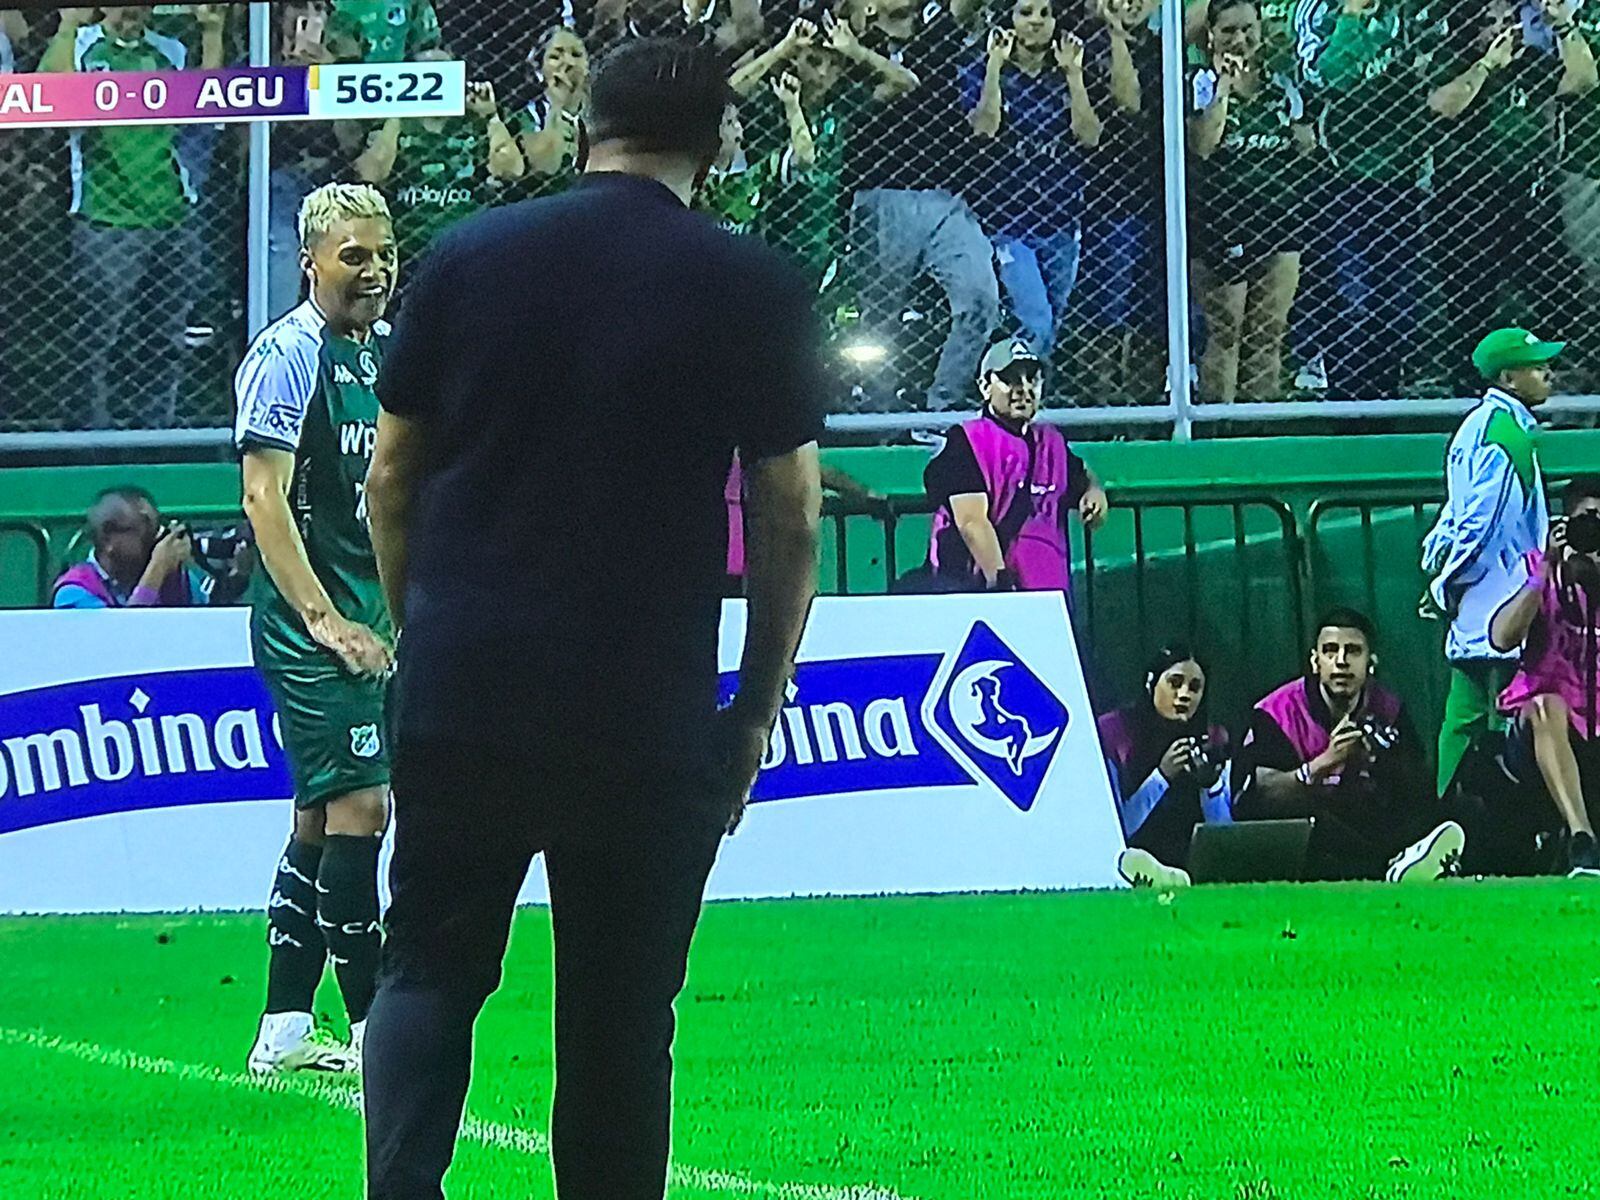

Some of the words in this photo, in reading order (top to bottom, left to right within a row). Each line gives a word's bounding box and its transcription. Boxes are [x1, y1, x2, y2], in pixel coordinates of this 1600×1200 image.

[0, 83, 54, 114] AL
[195, 76, 284, 109] AGU
[336, 72, 444, 104] 56:22
[0, 687, 269, 799] mbina
